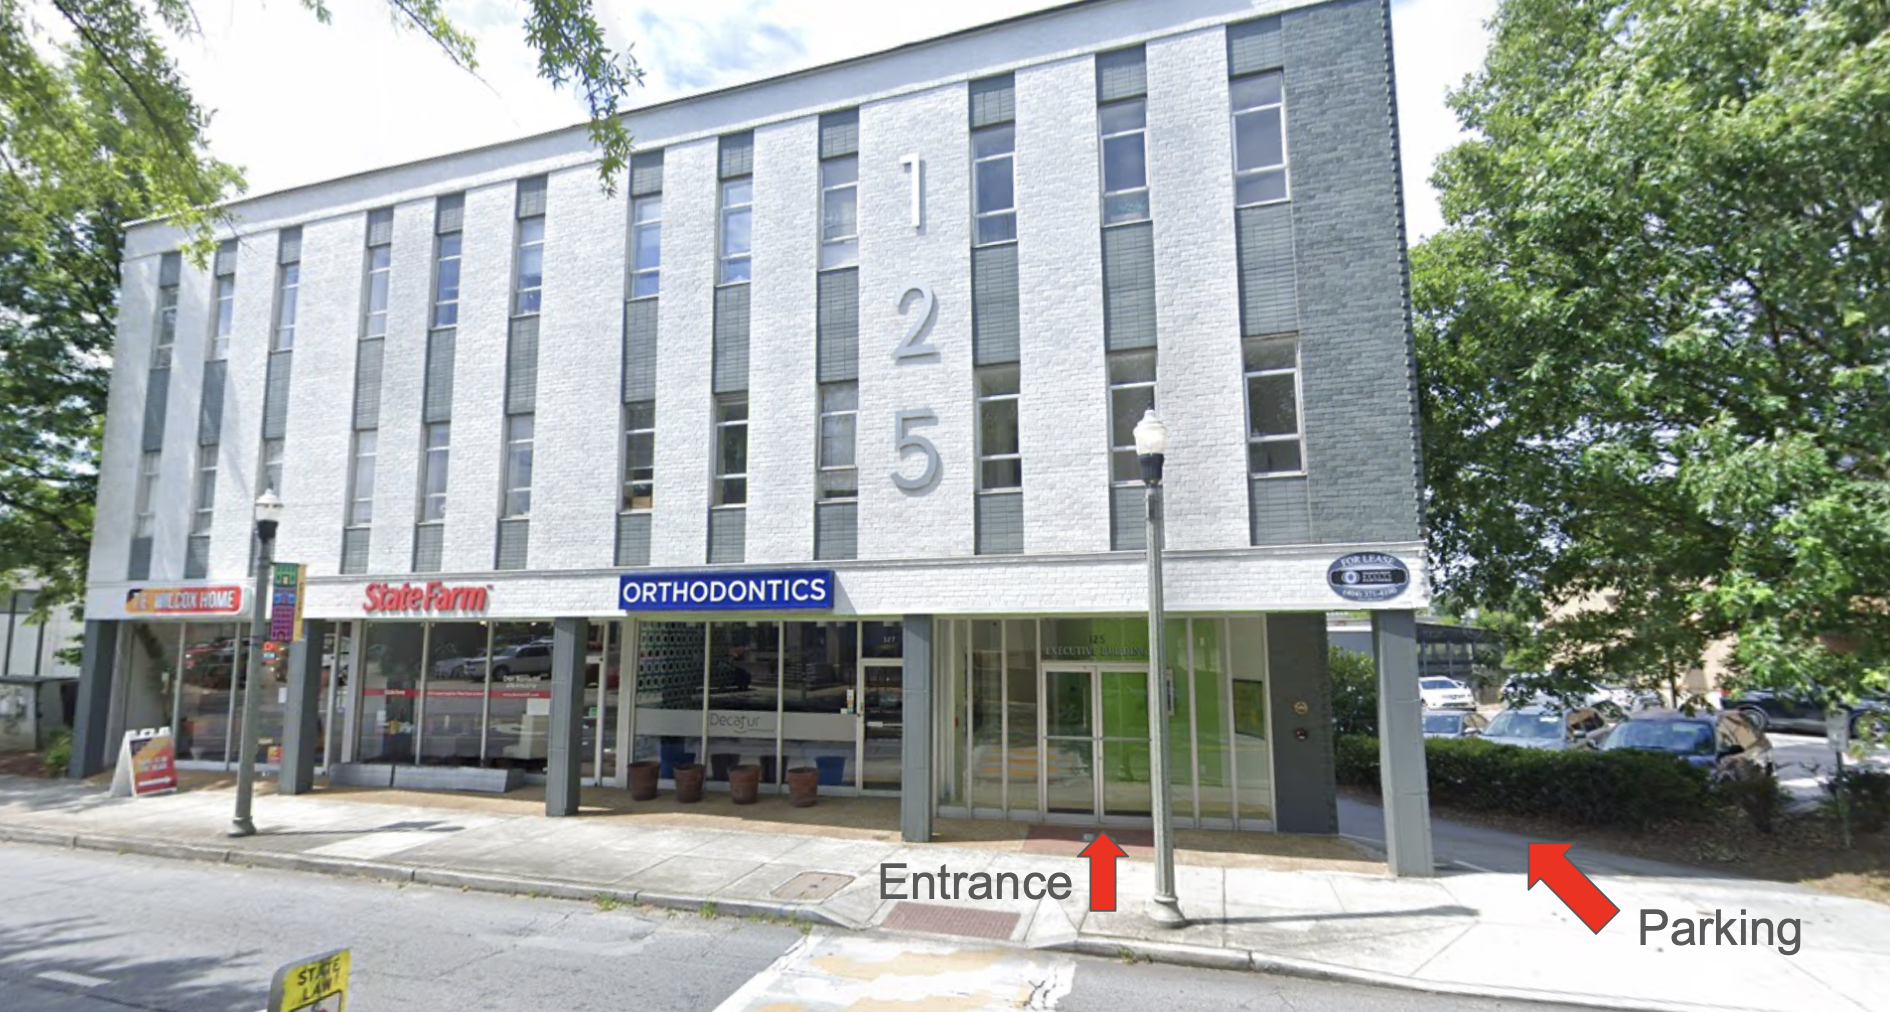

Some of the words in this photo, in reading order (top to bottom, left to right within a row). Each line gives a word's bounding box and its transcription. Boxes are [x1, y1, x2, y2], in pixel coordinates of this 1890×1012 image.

[890, 152, 940, 491] 125
[1341, 555, 1361, 567] FOR
[1362, 554, 1397, 567] LEASE
[200, 590, 235, 608] HOME
[622, 578, 826, 603] ORTHODONTICS
[1088, 634, 1106, 644] 125
[1045, 645, 1098, 656] EXECUTIVE
[709, 712, 760, 729] Decatur
[297, 957, 341, 987] STATE
